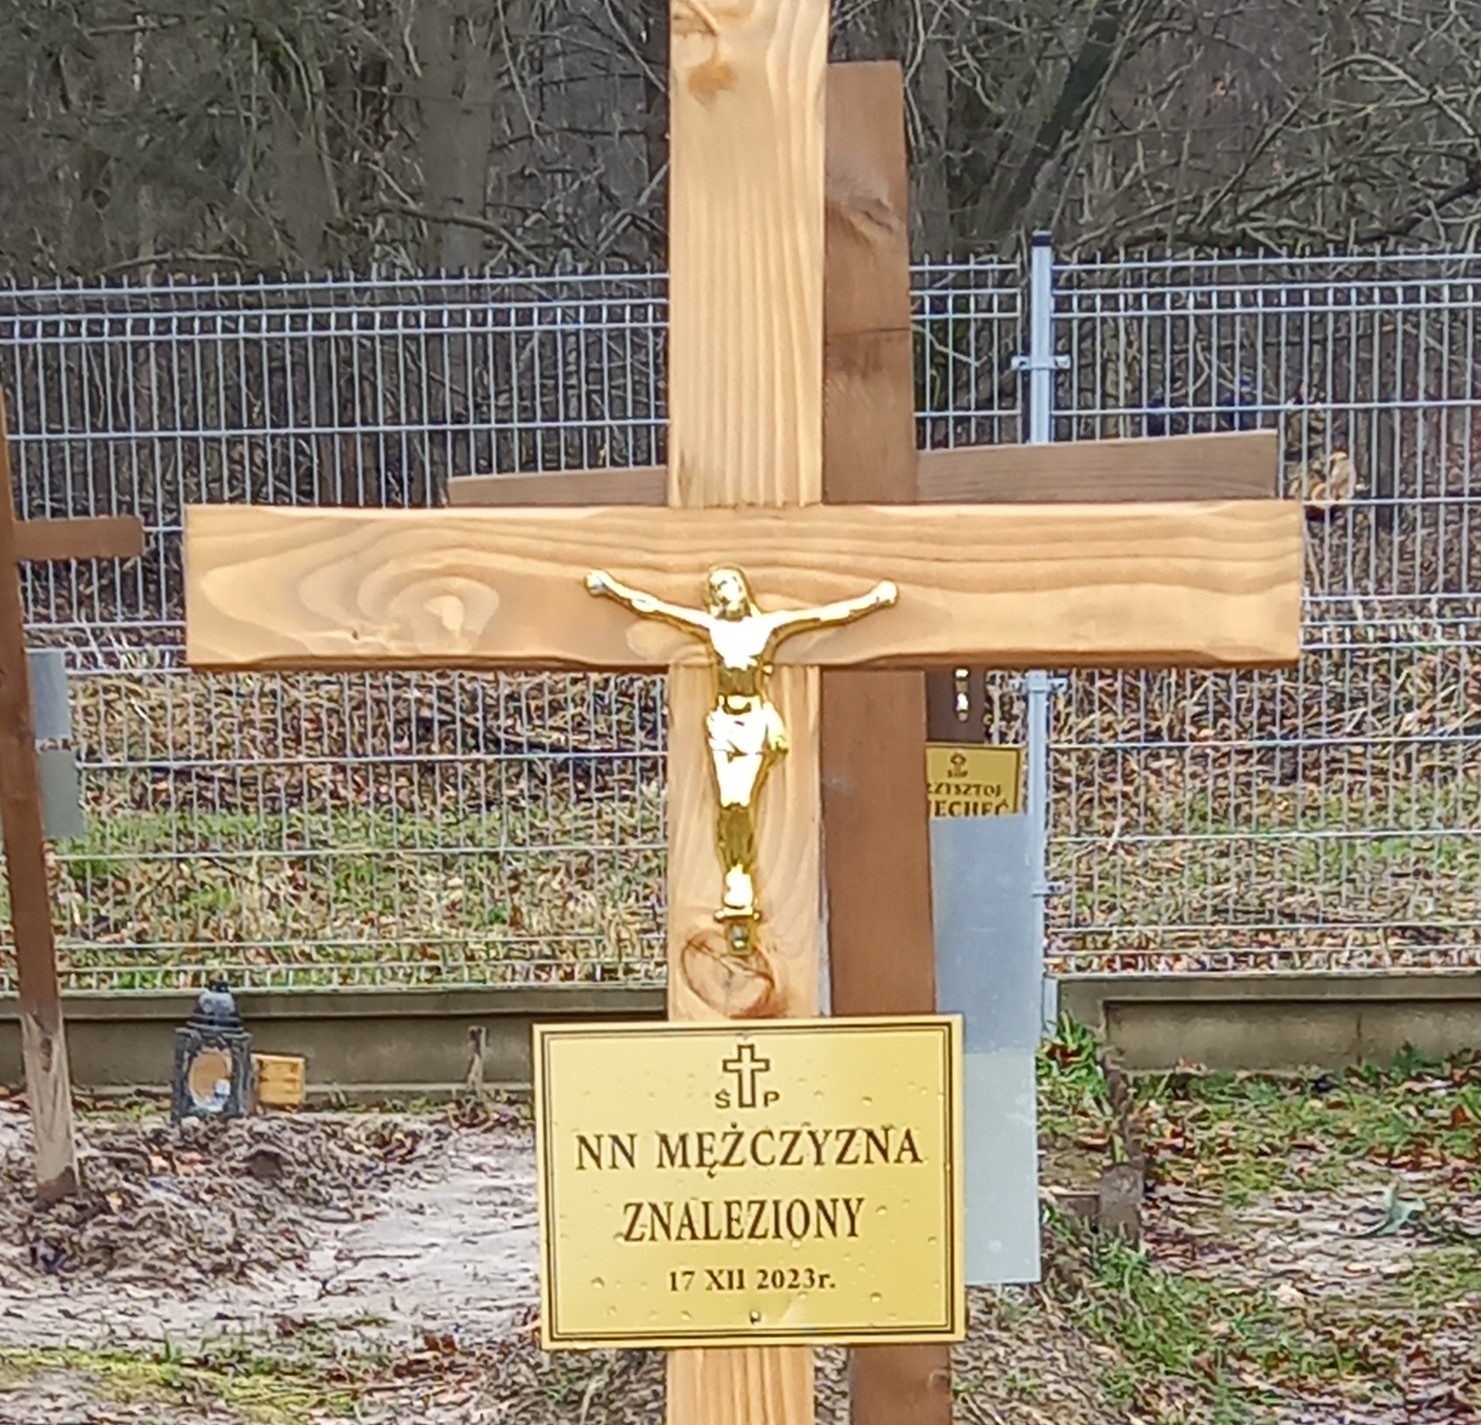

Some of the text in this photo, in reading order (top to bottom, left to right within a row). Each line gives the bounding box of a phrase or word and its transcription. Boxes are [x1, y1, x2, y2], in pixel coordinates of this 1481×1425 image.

[763, 1090, 780, 1108] P
[575, 1121, 923, 1179] NN MĘŻCZYZNA
[622, 1197, 865, 1242] ZNALEZIONY
[669, 1267, 836, 1291] 17 XII 2023r.
